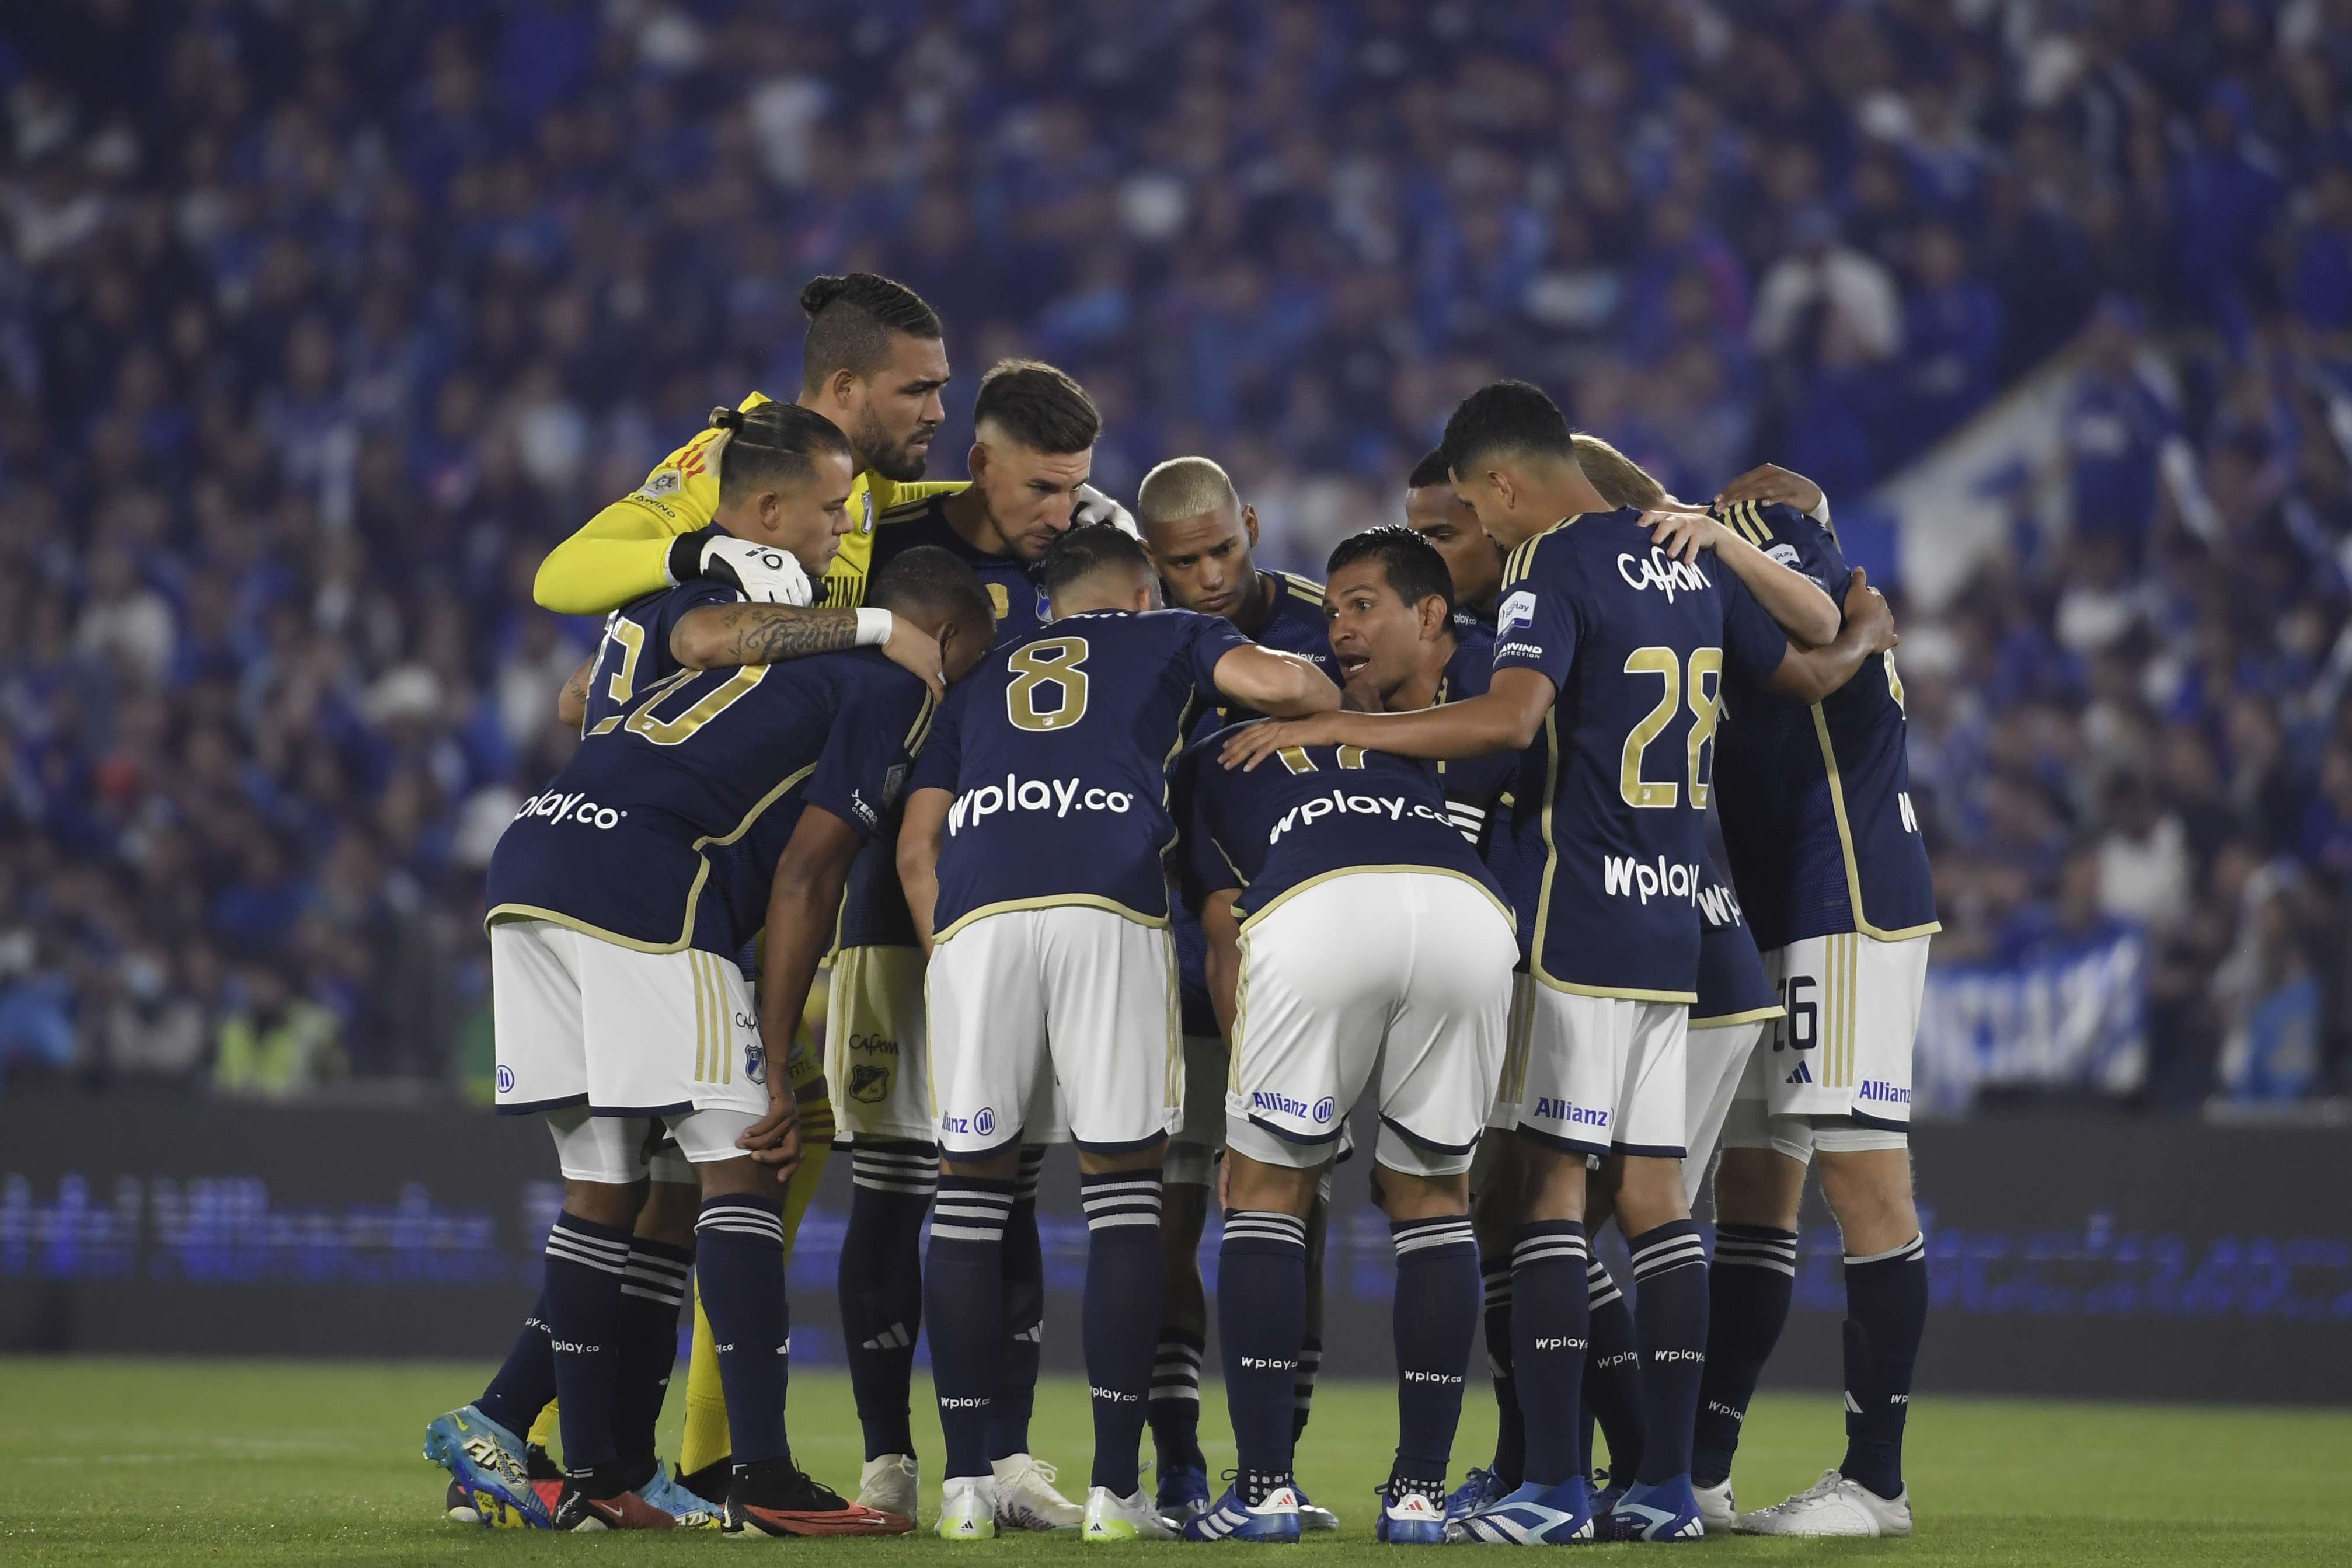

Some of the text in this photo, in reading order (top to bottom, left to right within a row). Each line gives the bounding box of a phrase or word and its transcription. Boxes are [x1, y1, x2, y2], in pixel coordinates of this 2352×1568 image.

[1006, 636, 1089, 731] 8
[1619, 646, 1723, 810] 28
[1252, 1092, 1308, 1119] Allianz
[1534, 1097, 1608, 1127] Allianz
[1405, 1370, 1462, 1384] Wplay.co
